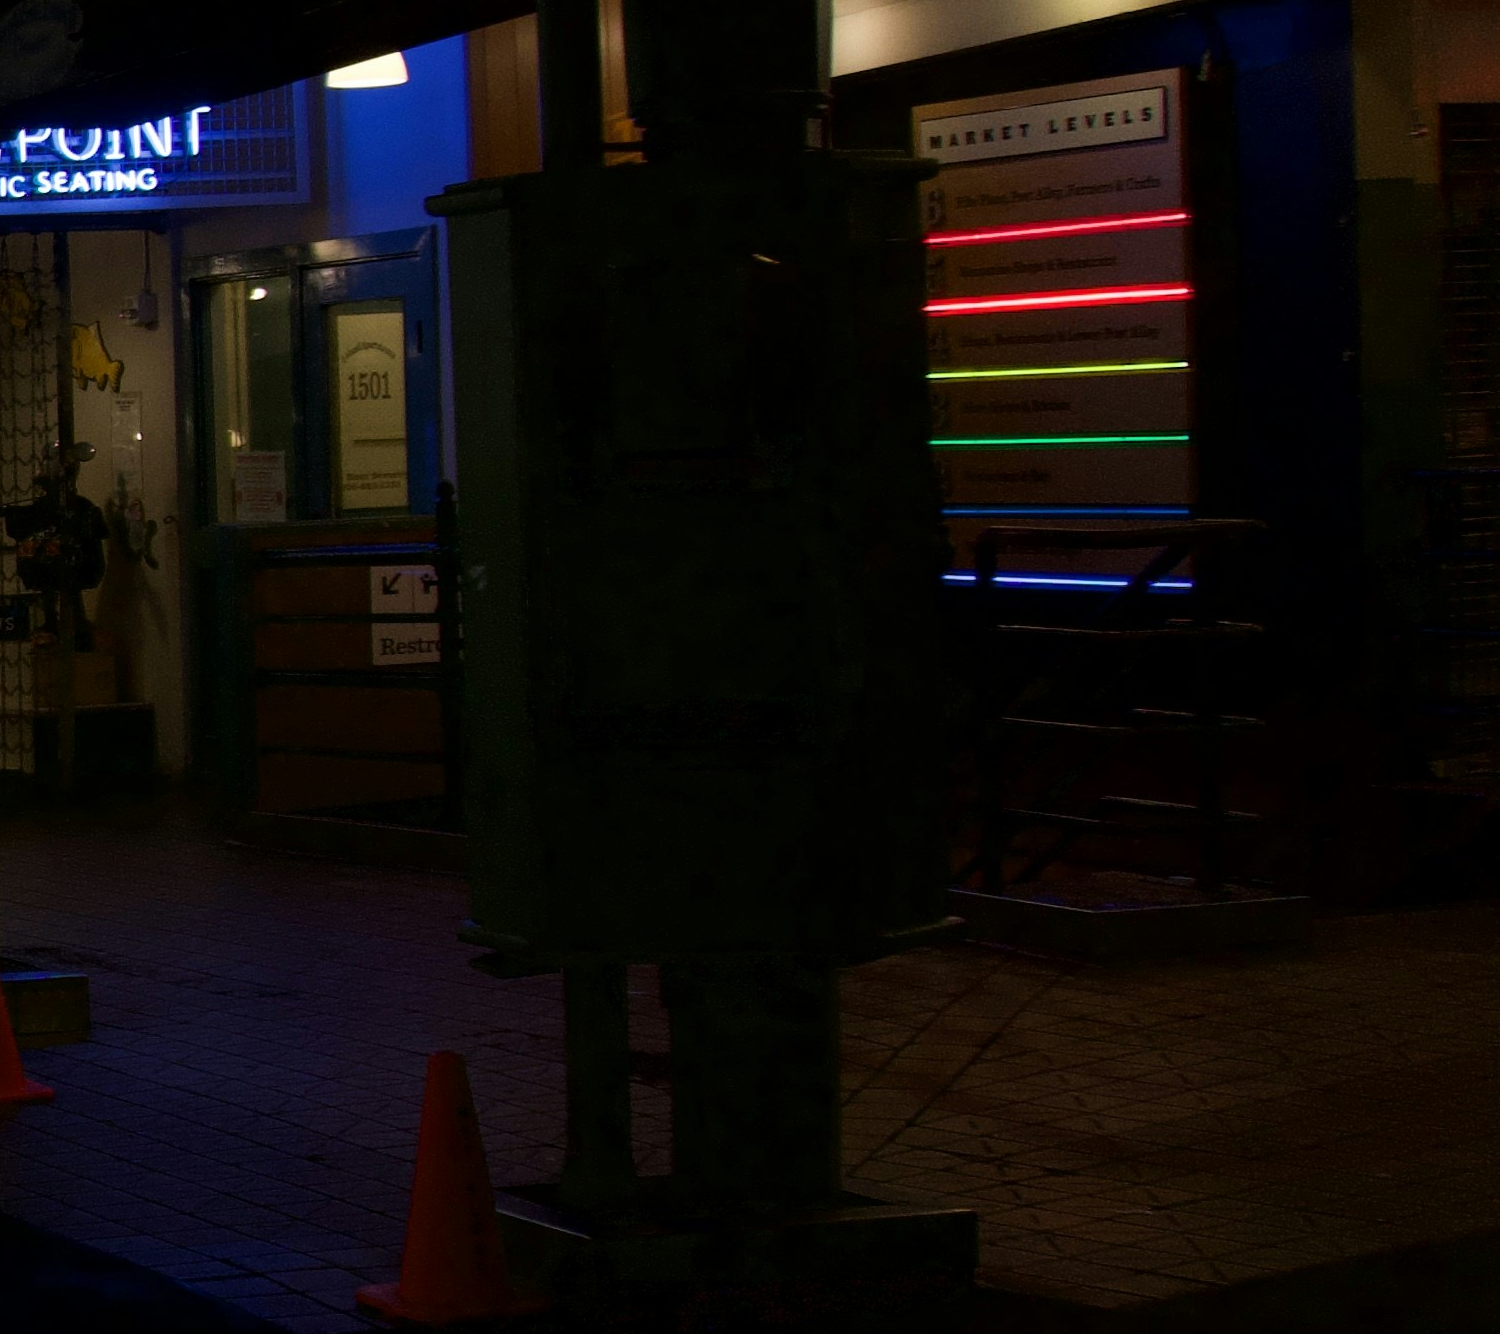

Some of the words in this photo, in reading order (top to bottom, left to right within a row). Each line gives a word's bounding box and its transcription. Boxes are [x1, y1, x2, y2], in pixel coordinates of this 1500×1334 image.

[931, 123, 1030, 149] MARKET
[1049, 106, 1154, 135] LEVELS
[36, 167, 158, 194] SEATING
[348, 371, 392, 400] 1501
